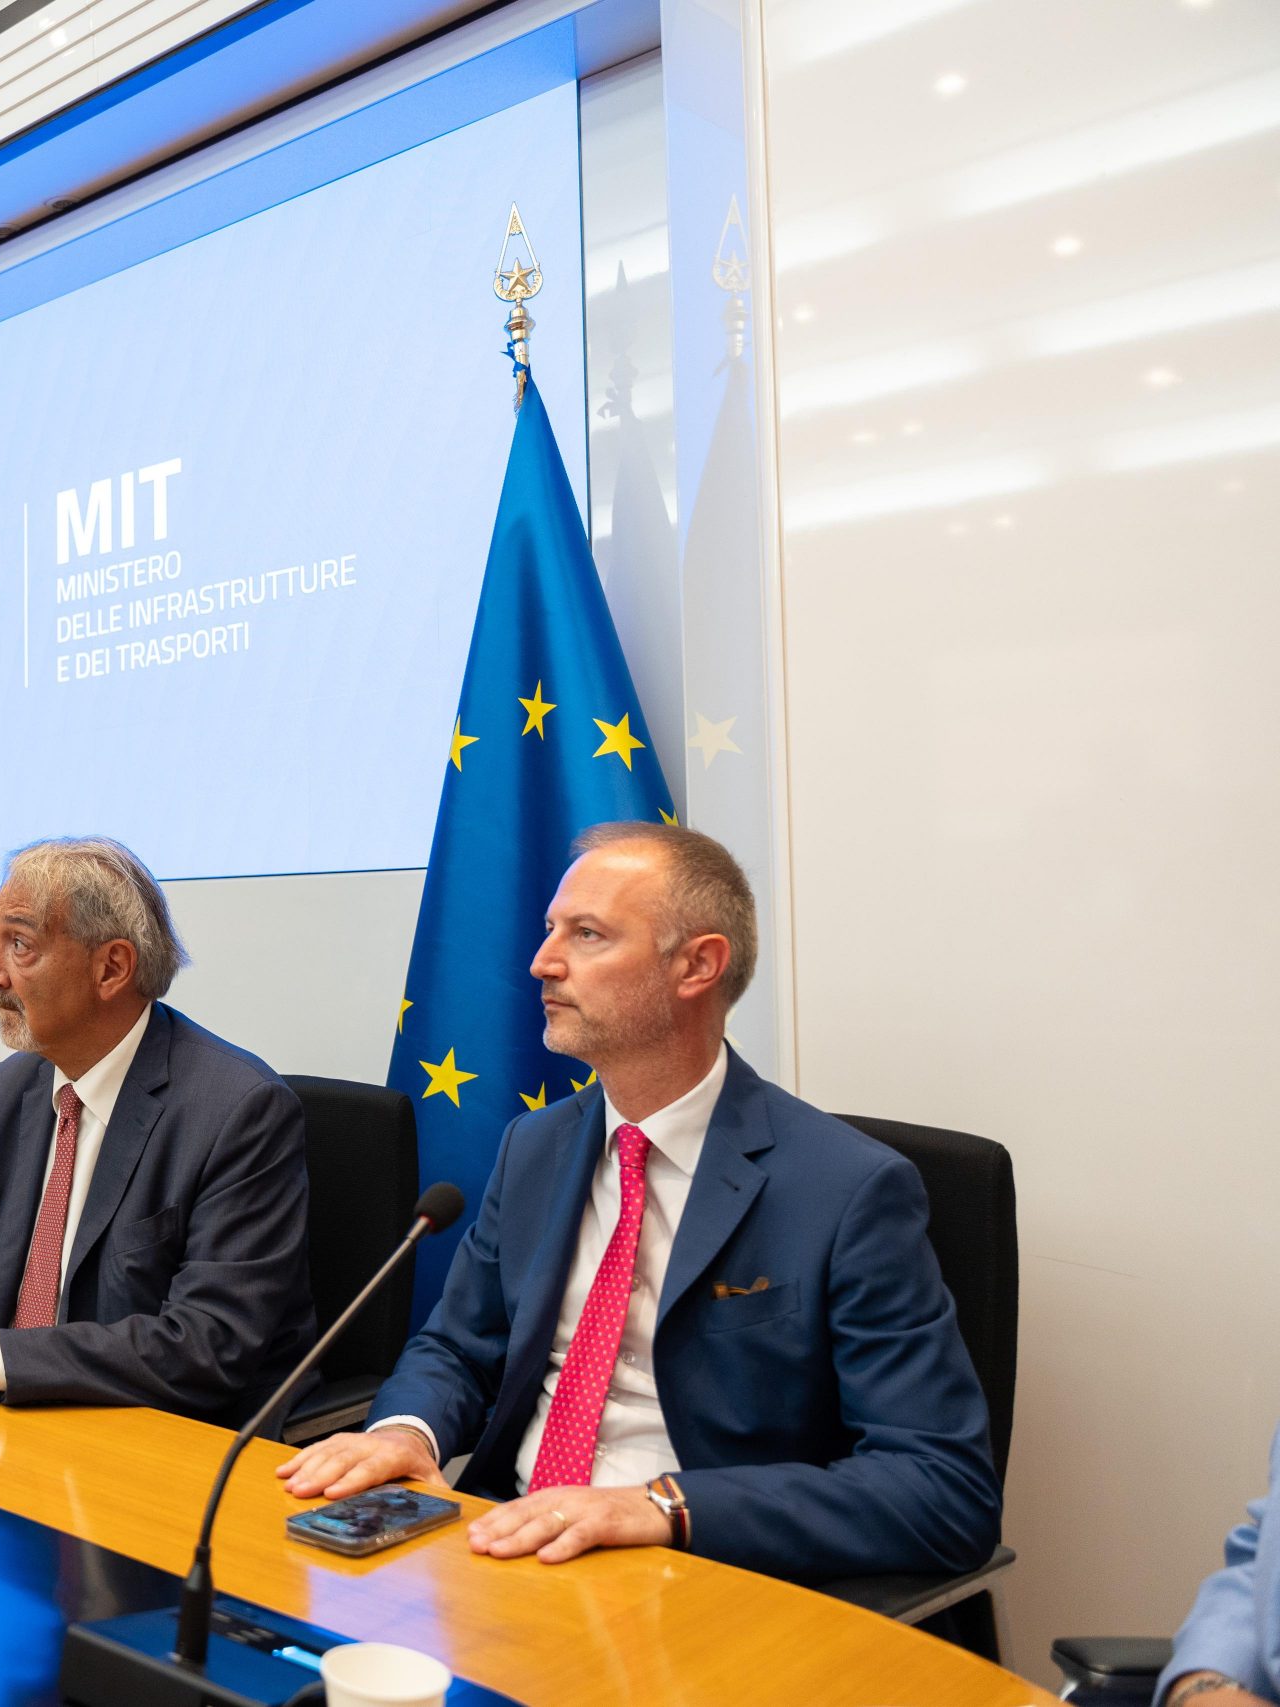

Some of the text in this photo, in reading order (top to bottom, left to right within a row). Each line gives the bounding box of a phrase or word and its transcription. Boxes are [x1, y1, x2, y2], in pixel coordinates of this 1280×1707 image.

[56, 457, 182, 565] MIT
[56, 550, 182, 604] MINISTERO
[56, 553, 357, 643] DELLE INFRASTRUTTURE
[56, 621, 250, 682] E DEI TRASPORTI
